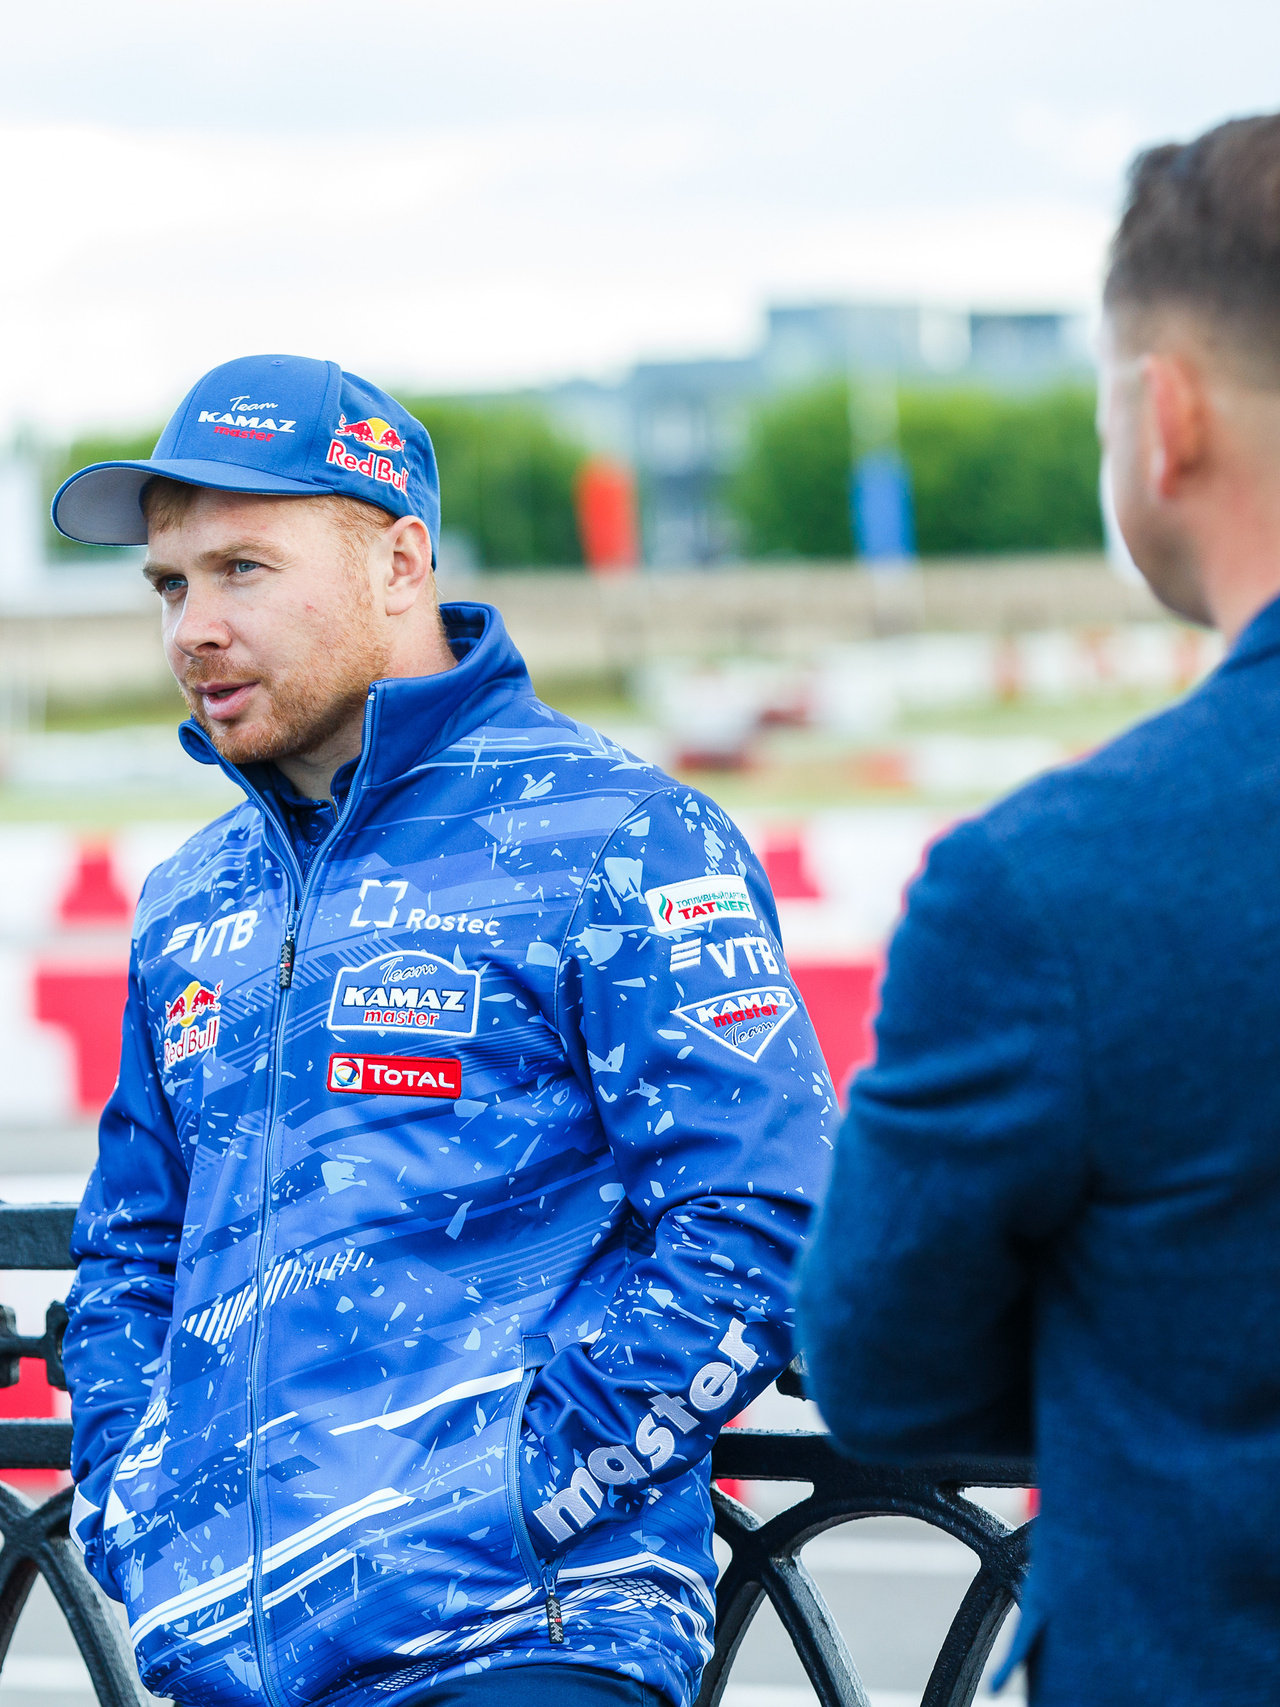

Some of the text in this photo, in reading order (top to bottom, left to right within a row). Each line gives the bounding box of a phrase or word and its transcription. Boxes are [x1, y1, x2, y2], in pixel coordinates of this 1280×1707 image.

[230, 395, 278, 412] Team
[198, 411, 297, 433] KAMAZ
[213, 425, 275, 442] master
[326, 439, 376, 478] Red
[405, 908, 501, 936] Rostec
[678, 900, 751, 920] TATNEFT
[190, 910, 258, 963] VTB
[380, 956, 438, 985] Team
[705, 936, 780, 979] VTB
[342, 985, 469, 1012] KAMAZ
[696, 992, 791, 1024] KAMAZ
[363, 1008, 440, 1027] master
[713, 1004, 779, 1028] master
[164, 1015, 220, 1071] Red Bull
[724, 1021, 775, 1047] Team
[368, 1064, 455, 1089] TOTAL
[532, 1317, 760, 1544] master
